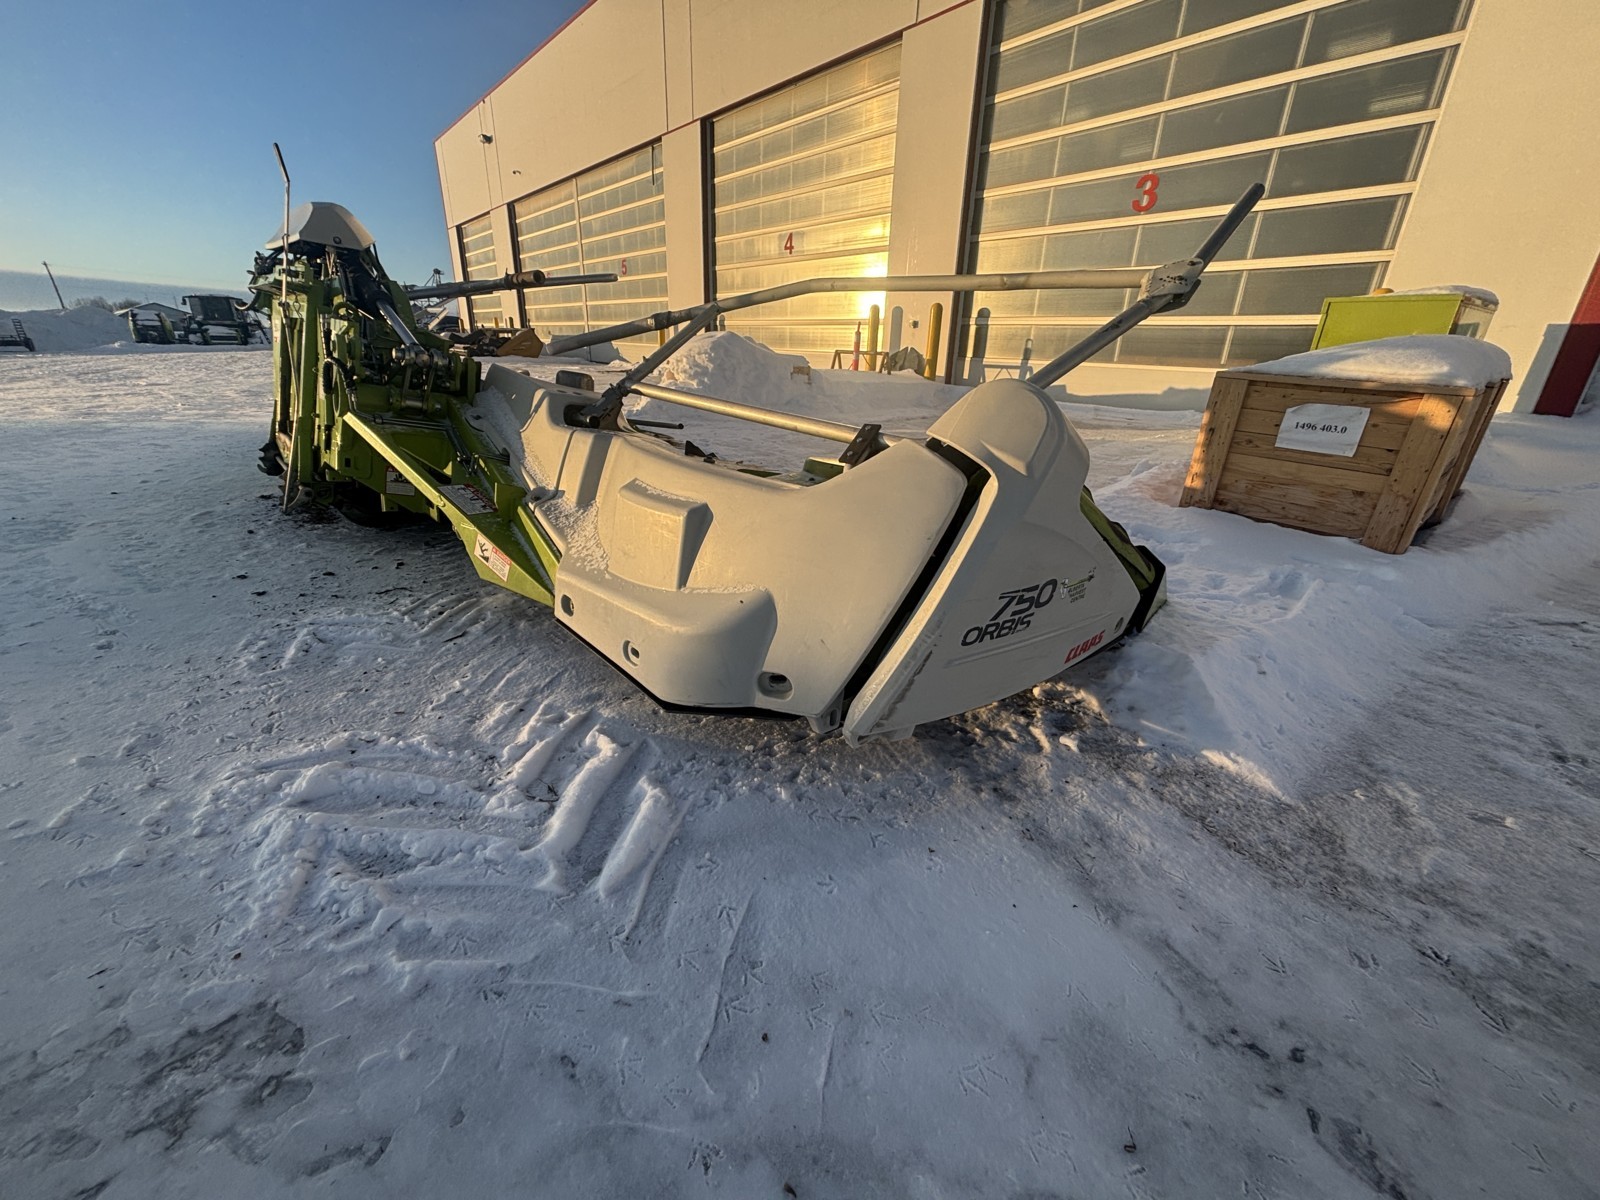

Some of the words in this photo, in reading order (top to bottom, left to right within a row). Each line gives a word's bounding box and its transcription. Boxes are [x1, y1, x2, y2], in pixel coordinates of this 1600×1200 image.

[1132, 173, 1159, 213] 3
[784, 232, 794, 255] 4
[621, 258, 628, 276] 5
[1294, 421, 1317, 431] 1496
[1319, 424, 1348, 434] 403.0
[989, 578, 1058, 622] 750
[960, 612, 1035, 647] ORBIS
[1064, 629, 1106, 664] CLAAS
